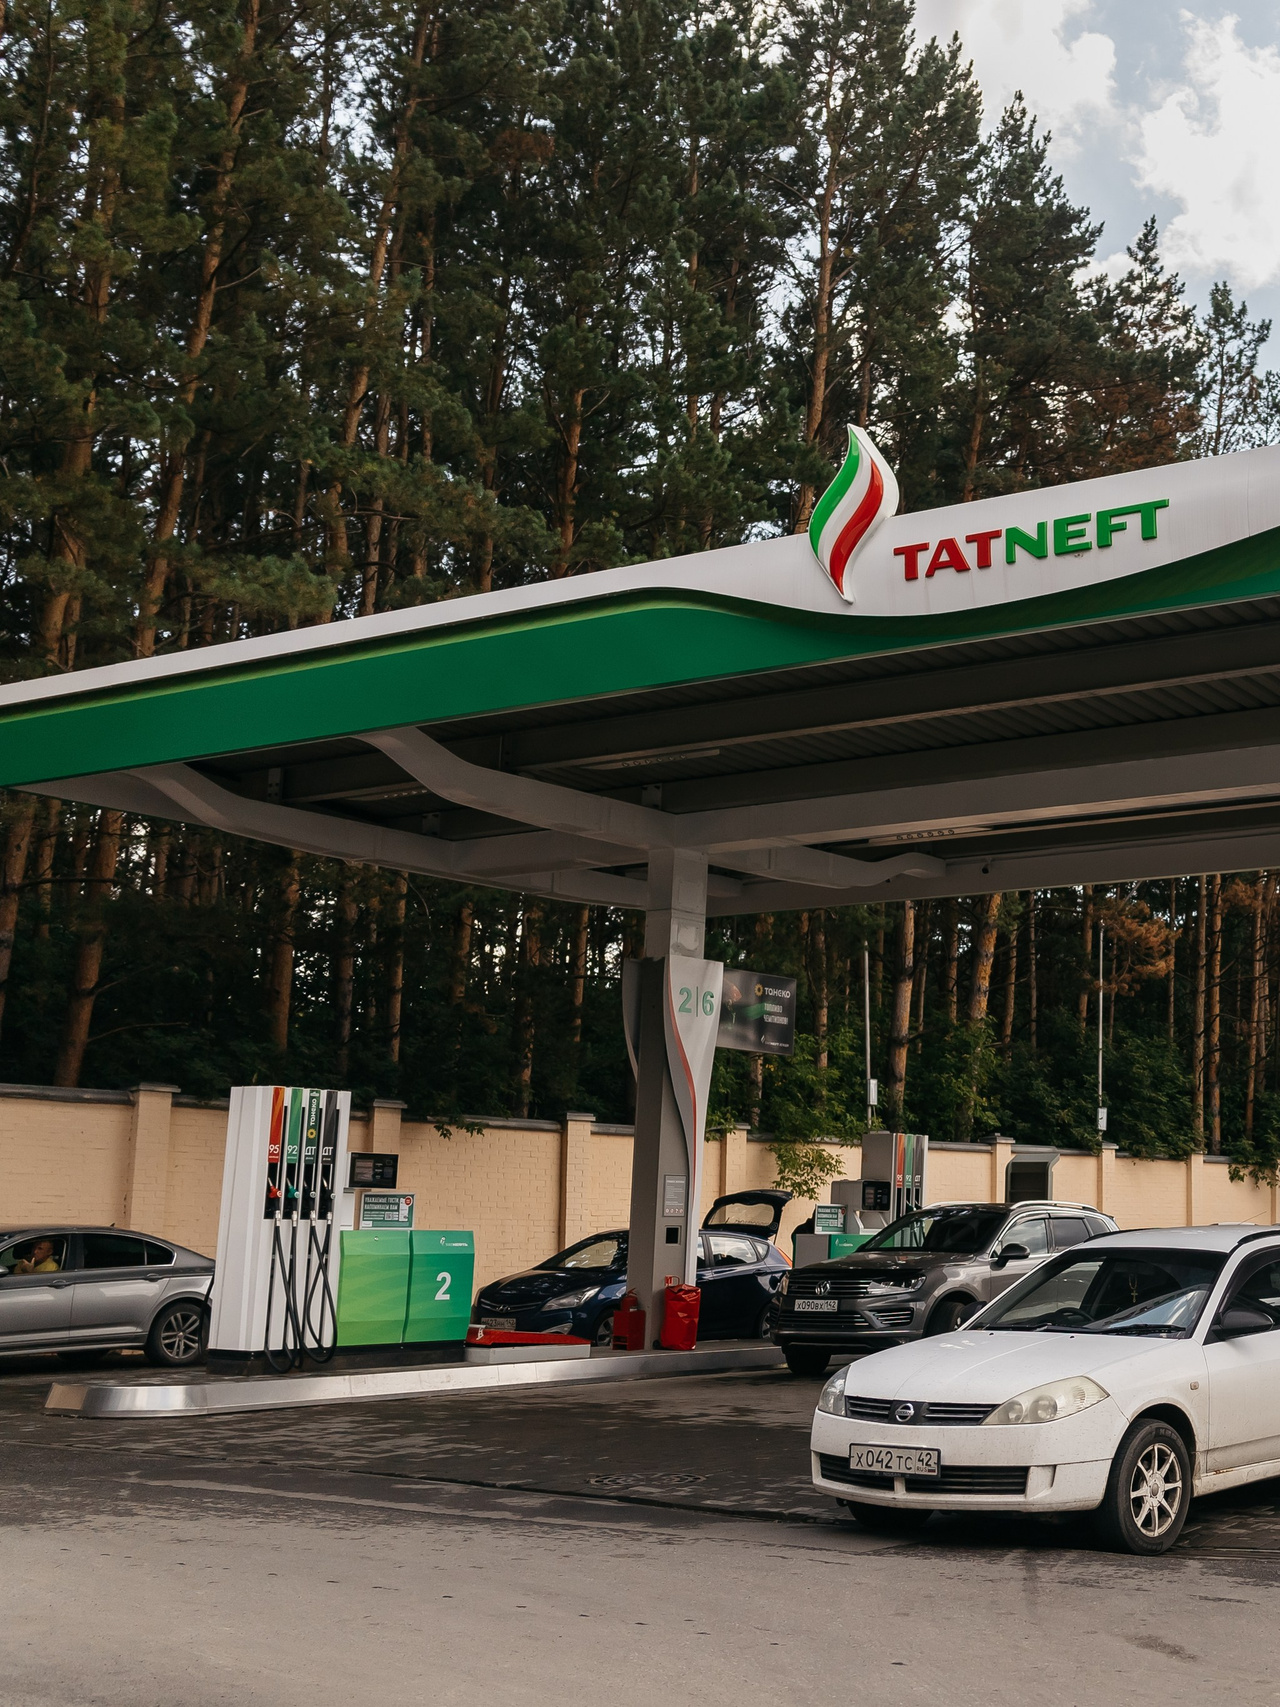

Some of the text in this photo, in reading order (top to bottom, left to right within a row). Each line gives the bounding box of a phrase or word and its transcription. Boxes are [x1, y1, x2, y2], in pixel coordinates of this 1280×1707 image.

[894, 499, 1170, 581] TATNEFT
[269, 1145, 279, 1154] 95
[287, 1145, 298, 1155] 92
[304, 1146, 316, 1155] ДТ
[322, 1146, 334, 1155] ДТ
[906, 1174, 912, 1182] 92
[434, 1271, 451, 1301] 2
[855, 1450, 932, 1471] Х042ТС 42
